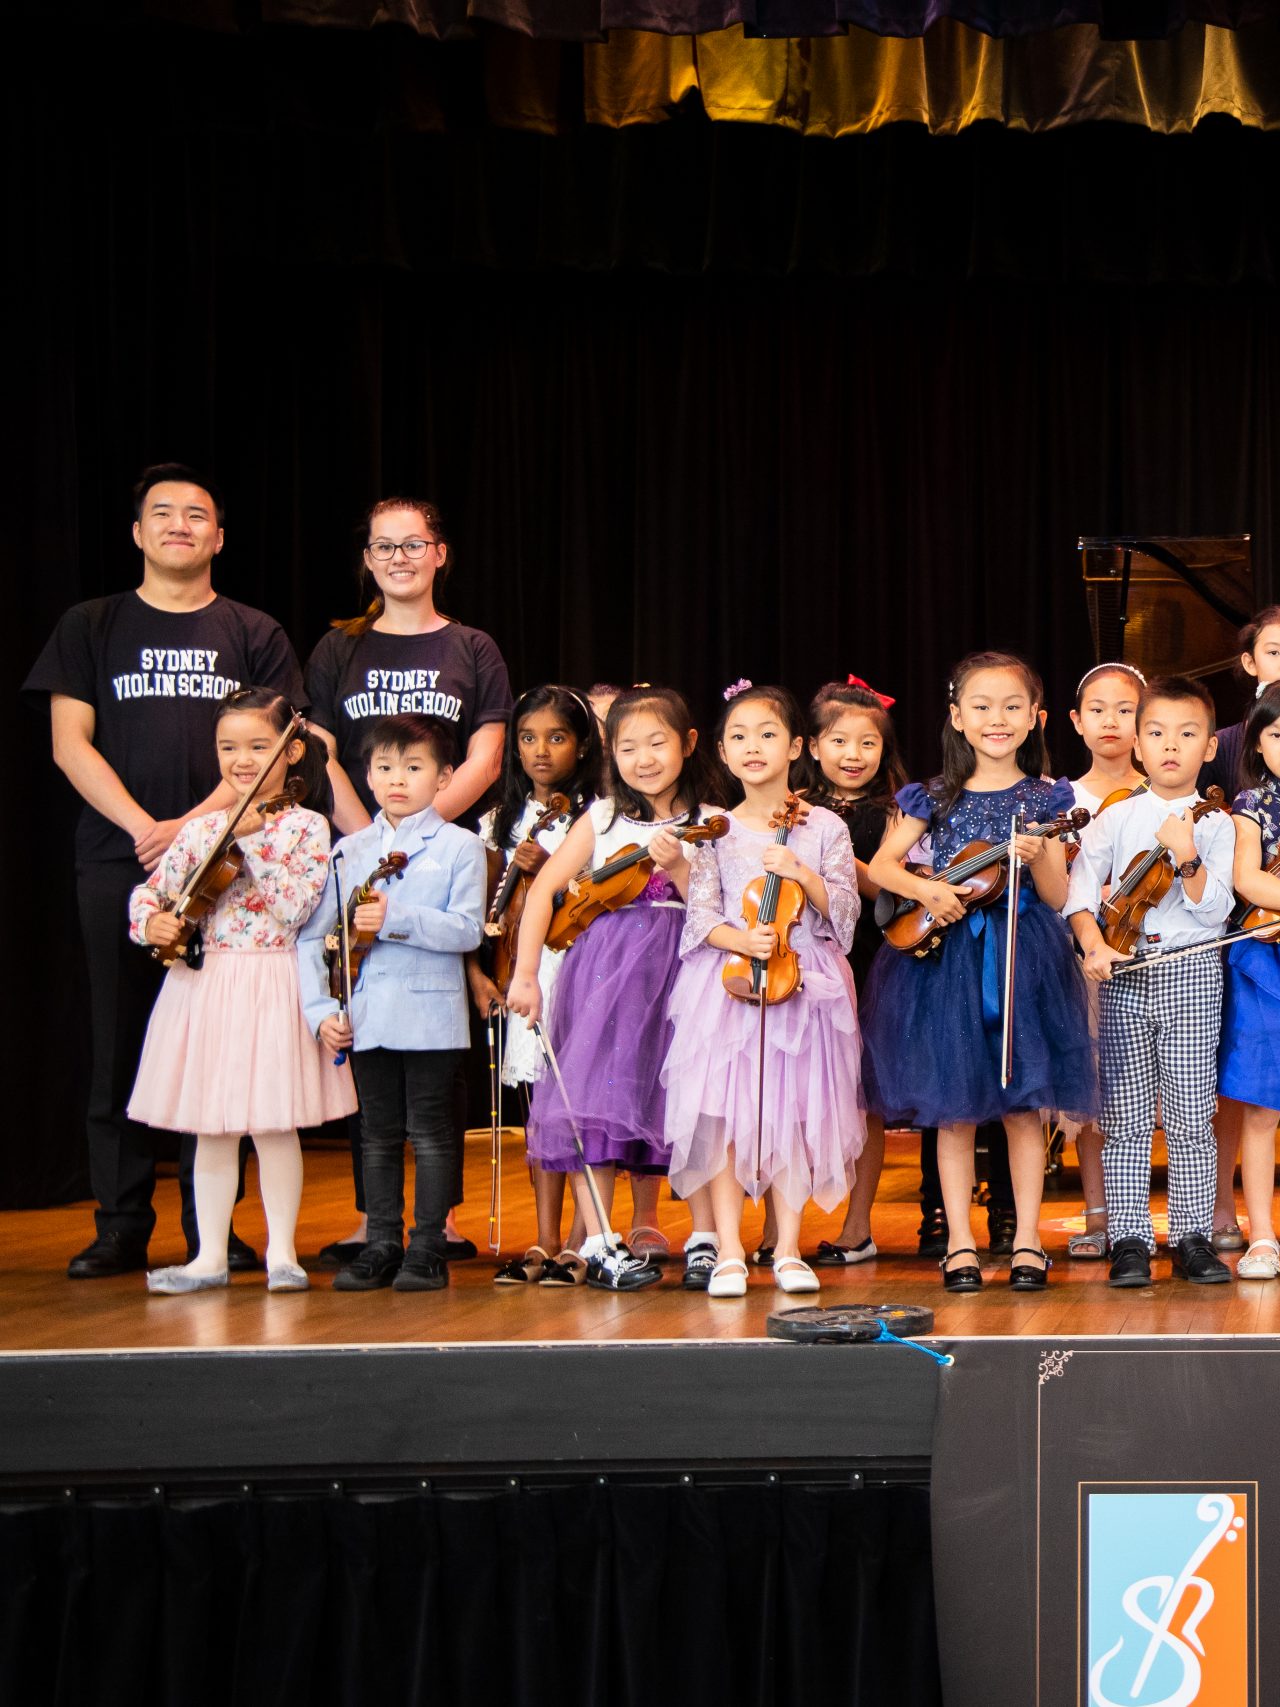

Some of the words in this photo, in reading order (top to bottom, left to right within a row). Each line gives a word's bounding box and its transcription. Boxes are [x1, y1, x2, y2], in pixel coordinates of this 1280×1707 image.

[141, 648, 218, 672] SYDNEY
[113, 673, 176, 700] VIOLIN
[367, 669, 440, 692] SYDNEY
[344, 691, 399, 720] VIOLIN
[400, 691, 462, 722] SCHOOL
